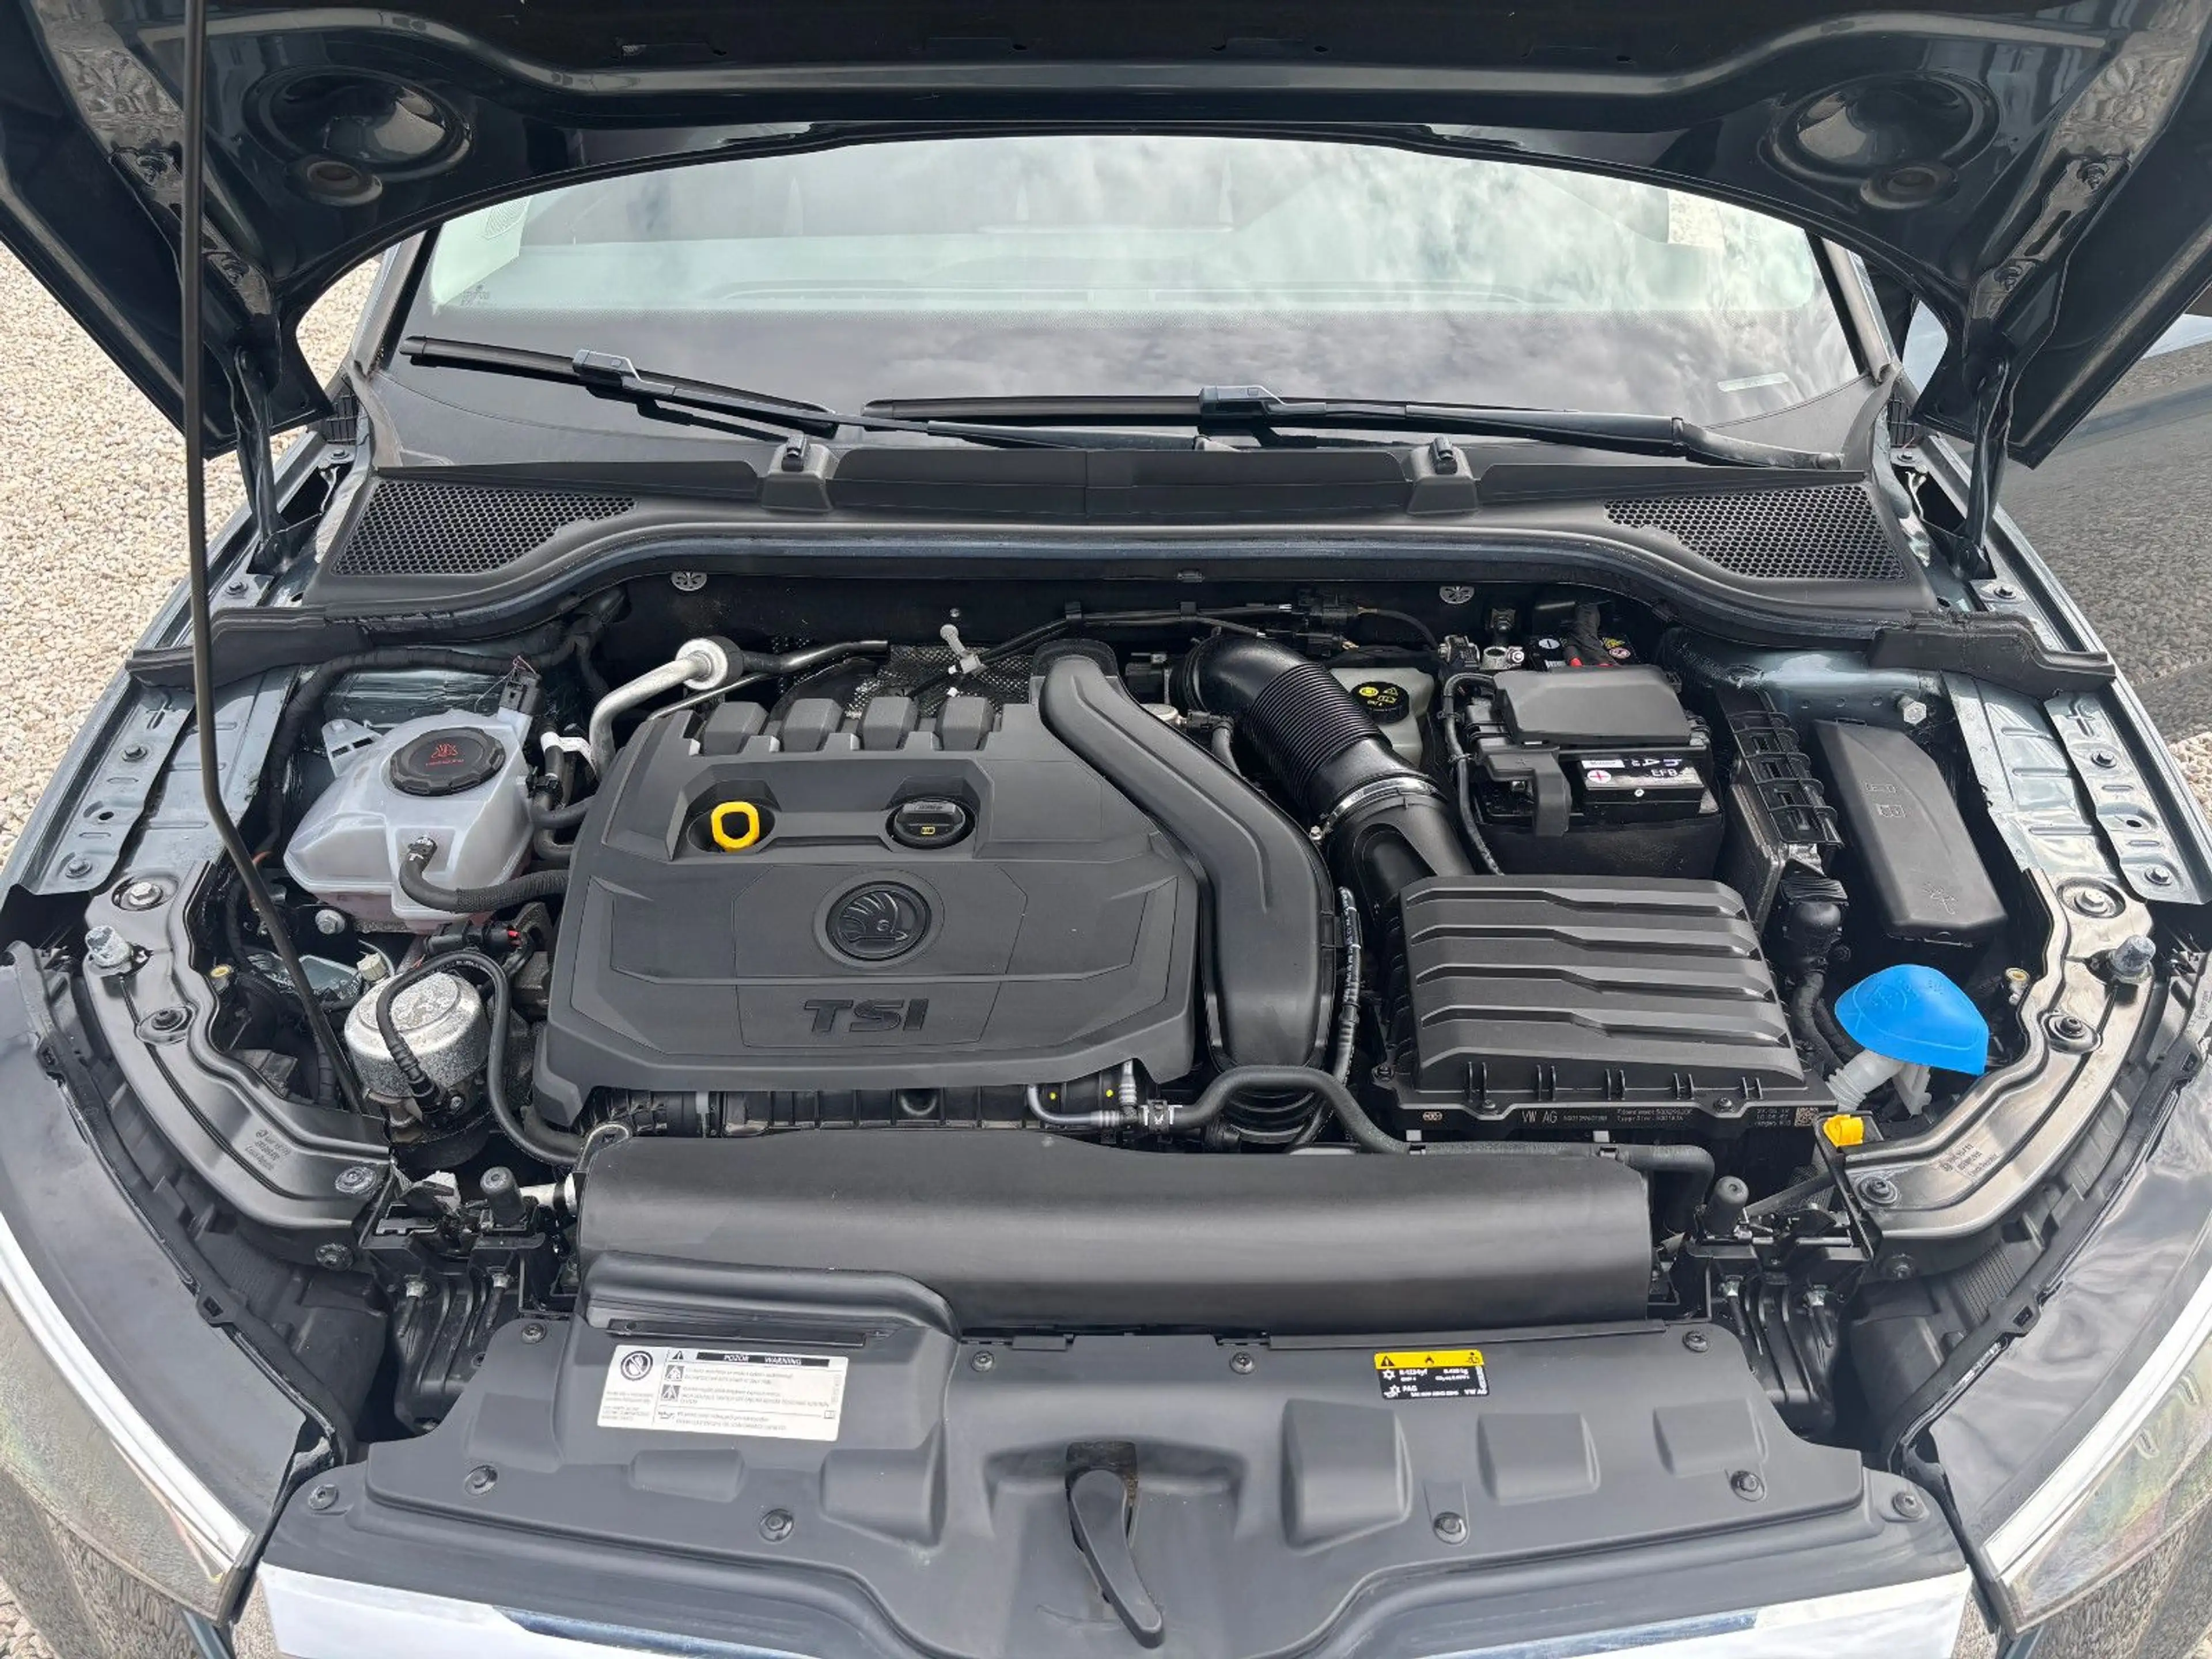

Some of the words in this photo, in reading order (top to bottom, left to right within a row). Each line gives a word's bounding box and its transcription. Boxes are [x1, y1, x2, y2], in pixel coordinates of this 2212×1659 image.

[804, 998, 929, 1032] TSI
[1521, 1110, 1537, 1123] VW
[1542, 1111, 1558, 1124] AG
[724, 1354, 750, 1363] POZOR
[764, 1356, 802, 1366] WARNING
